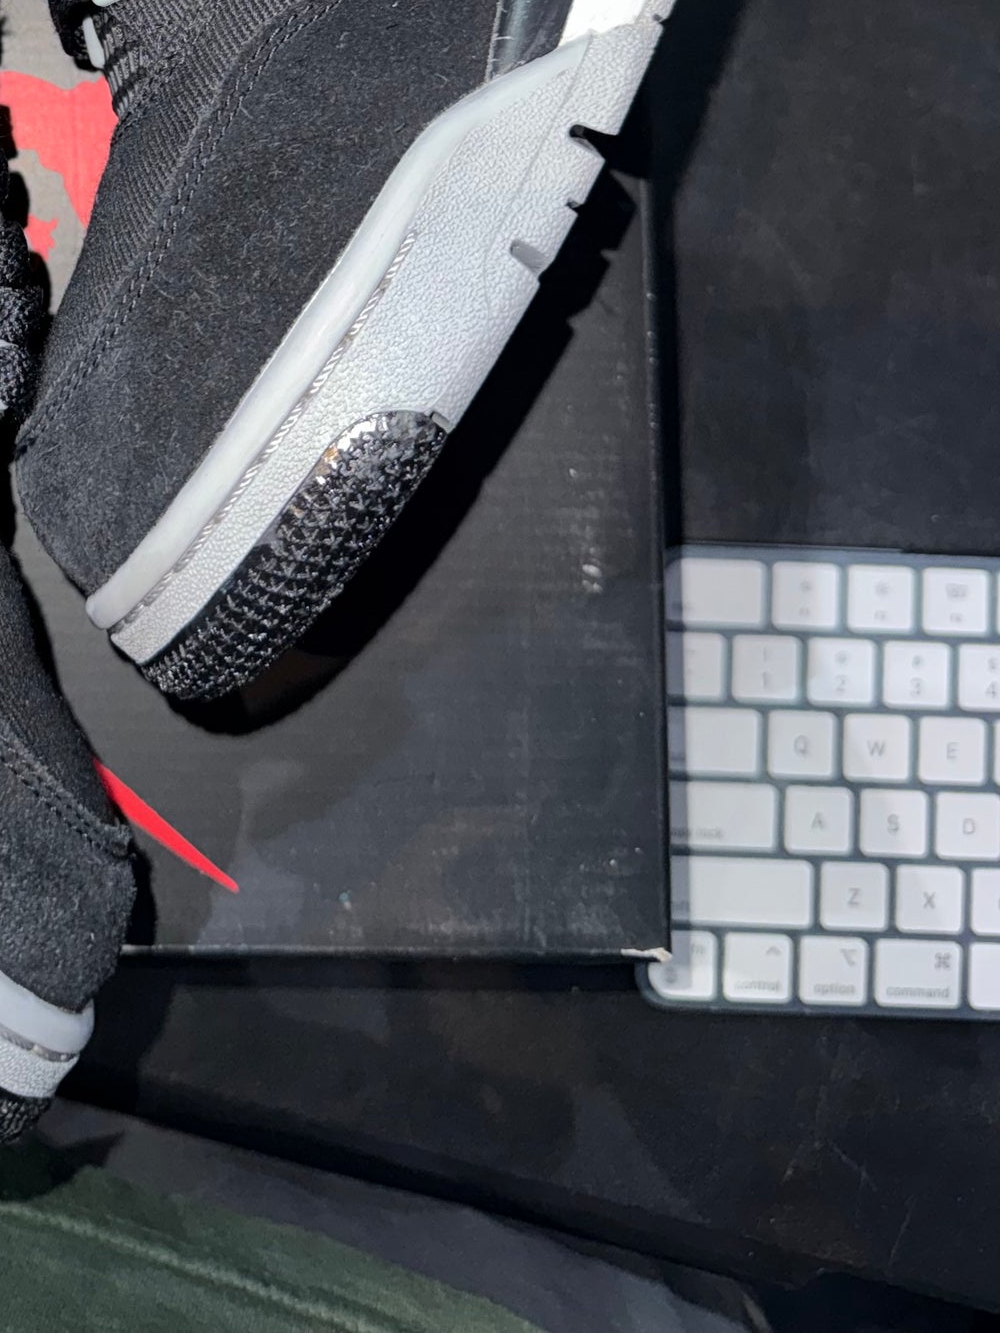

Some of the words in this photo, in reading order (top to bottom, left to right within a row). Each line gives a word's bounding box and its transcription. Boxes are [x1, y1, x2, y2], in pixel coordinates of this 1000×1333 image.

[835, 674, 847, 693] 2
[985, 681, 998, 699] 4
[794, 734, 810, 758] Q
[866, 739, 887, 757] W
[946, 741, 959, 761] E
[810, 811, 826, 830] A
[886, 814, 901, 834] S
[962, 818, 977, 835] D
[847, 887, 862, 907] Z
[921, 891, 937, 910] X
[812, 980, 856, 996] option
[885, 983, 951, 999] command
